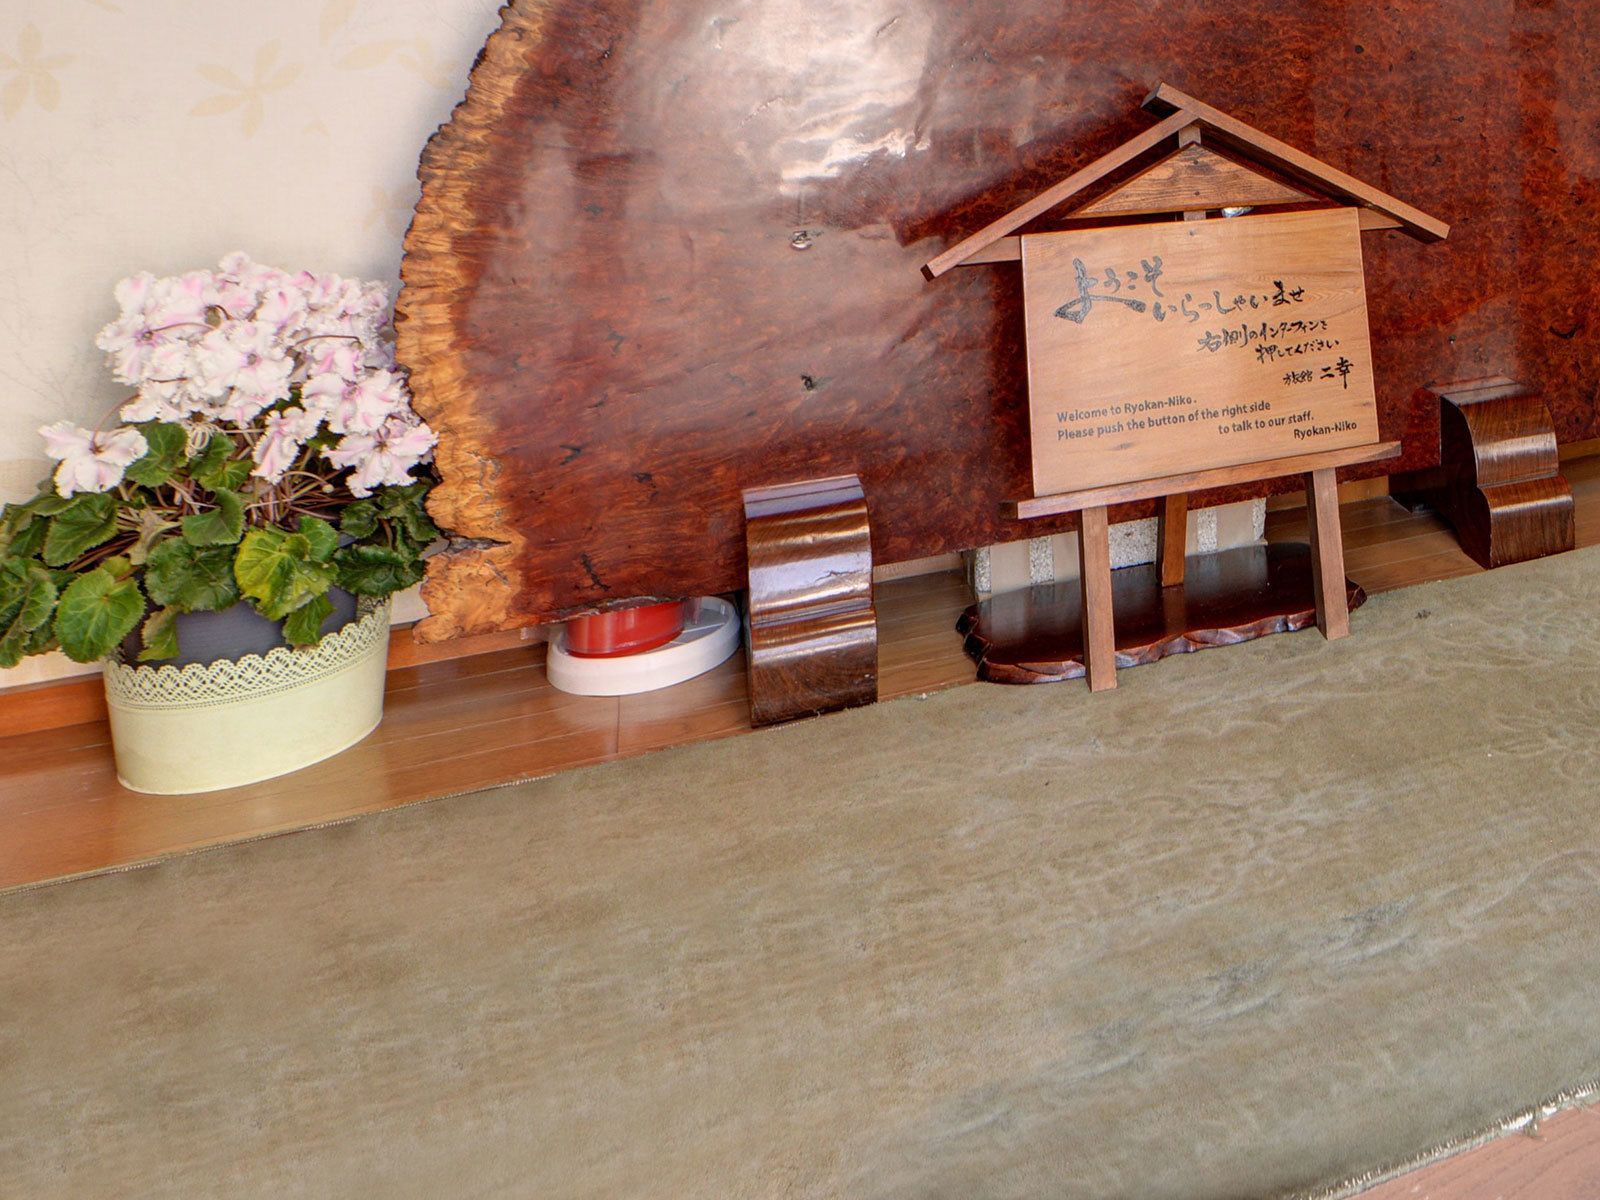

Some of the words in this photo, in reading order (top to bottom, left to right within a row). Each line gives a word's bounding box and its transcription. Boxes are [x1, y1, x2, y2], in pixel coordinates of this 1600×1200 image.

[1053, 255, 1164, 324] ようこそ
[1152, 279, 1305, 323] いらっしゃいませ
[1255, 337, 1340, 364] 押してください
[1056, 407, 1108, 423] Welcome
[1110, 405, 1122, 415] to
[1124, 395, 1197, 414] Ryokan-Niko.
[1057, 428, 1094, 441] Please
[1097, 421, 1124, 438] push
[1126, 418, 1145, 430] the
[1147, 413, 1186, 428] button
[1188, 410, 1200, 421] of
[1201, 407, 1220, 419] the
[1221, 402, 1248, 418] right
[1249, 400, 1271, 413] side
[1218, 424, 1230, 435] to
[1231, 420, 1253, 433] talk
[1255, 419, 1266, 430] to
[1268, 416, 1286, 427] our
[1287, 410, 1315, 425] staff.
[1293, 420, 1358, 441] Ryokan-Niko
